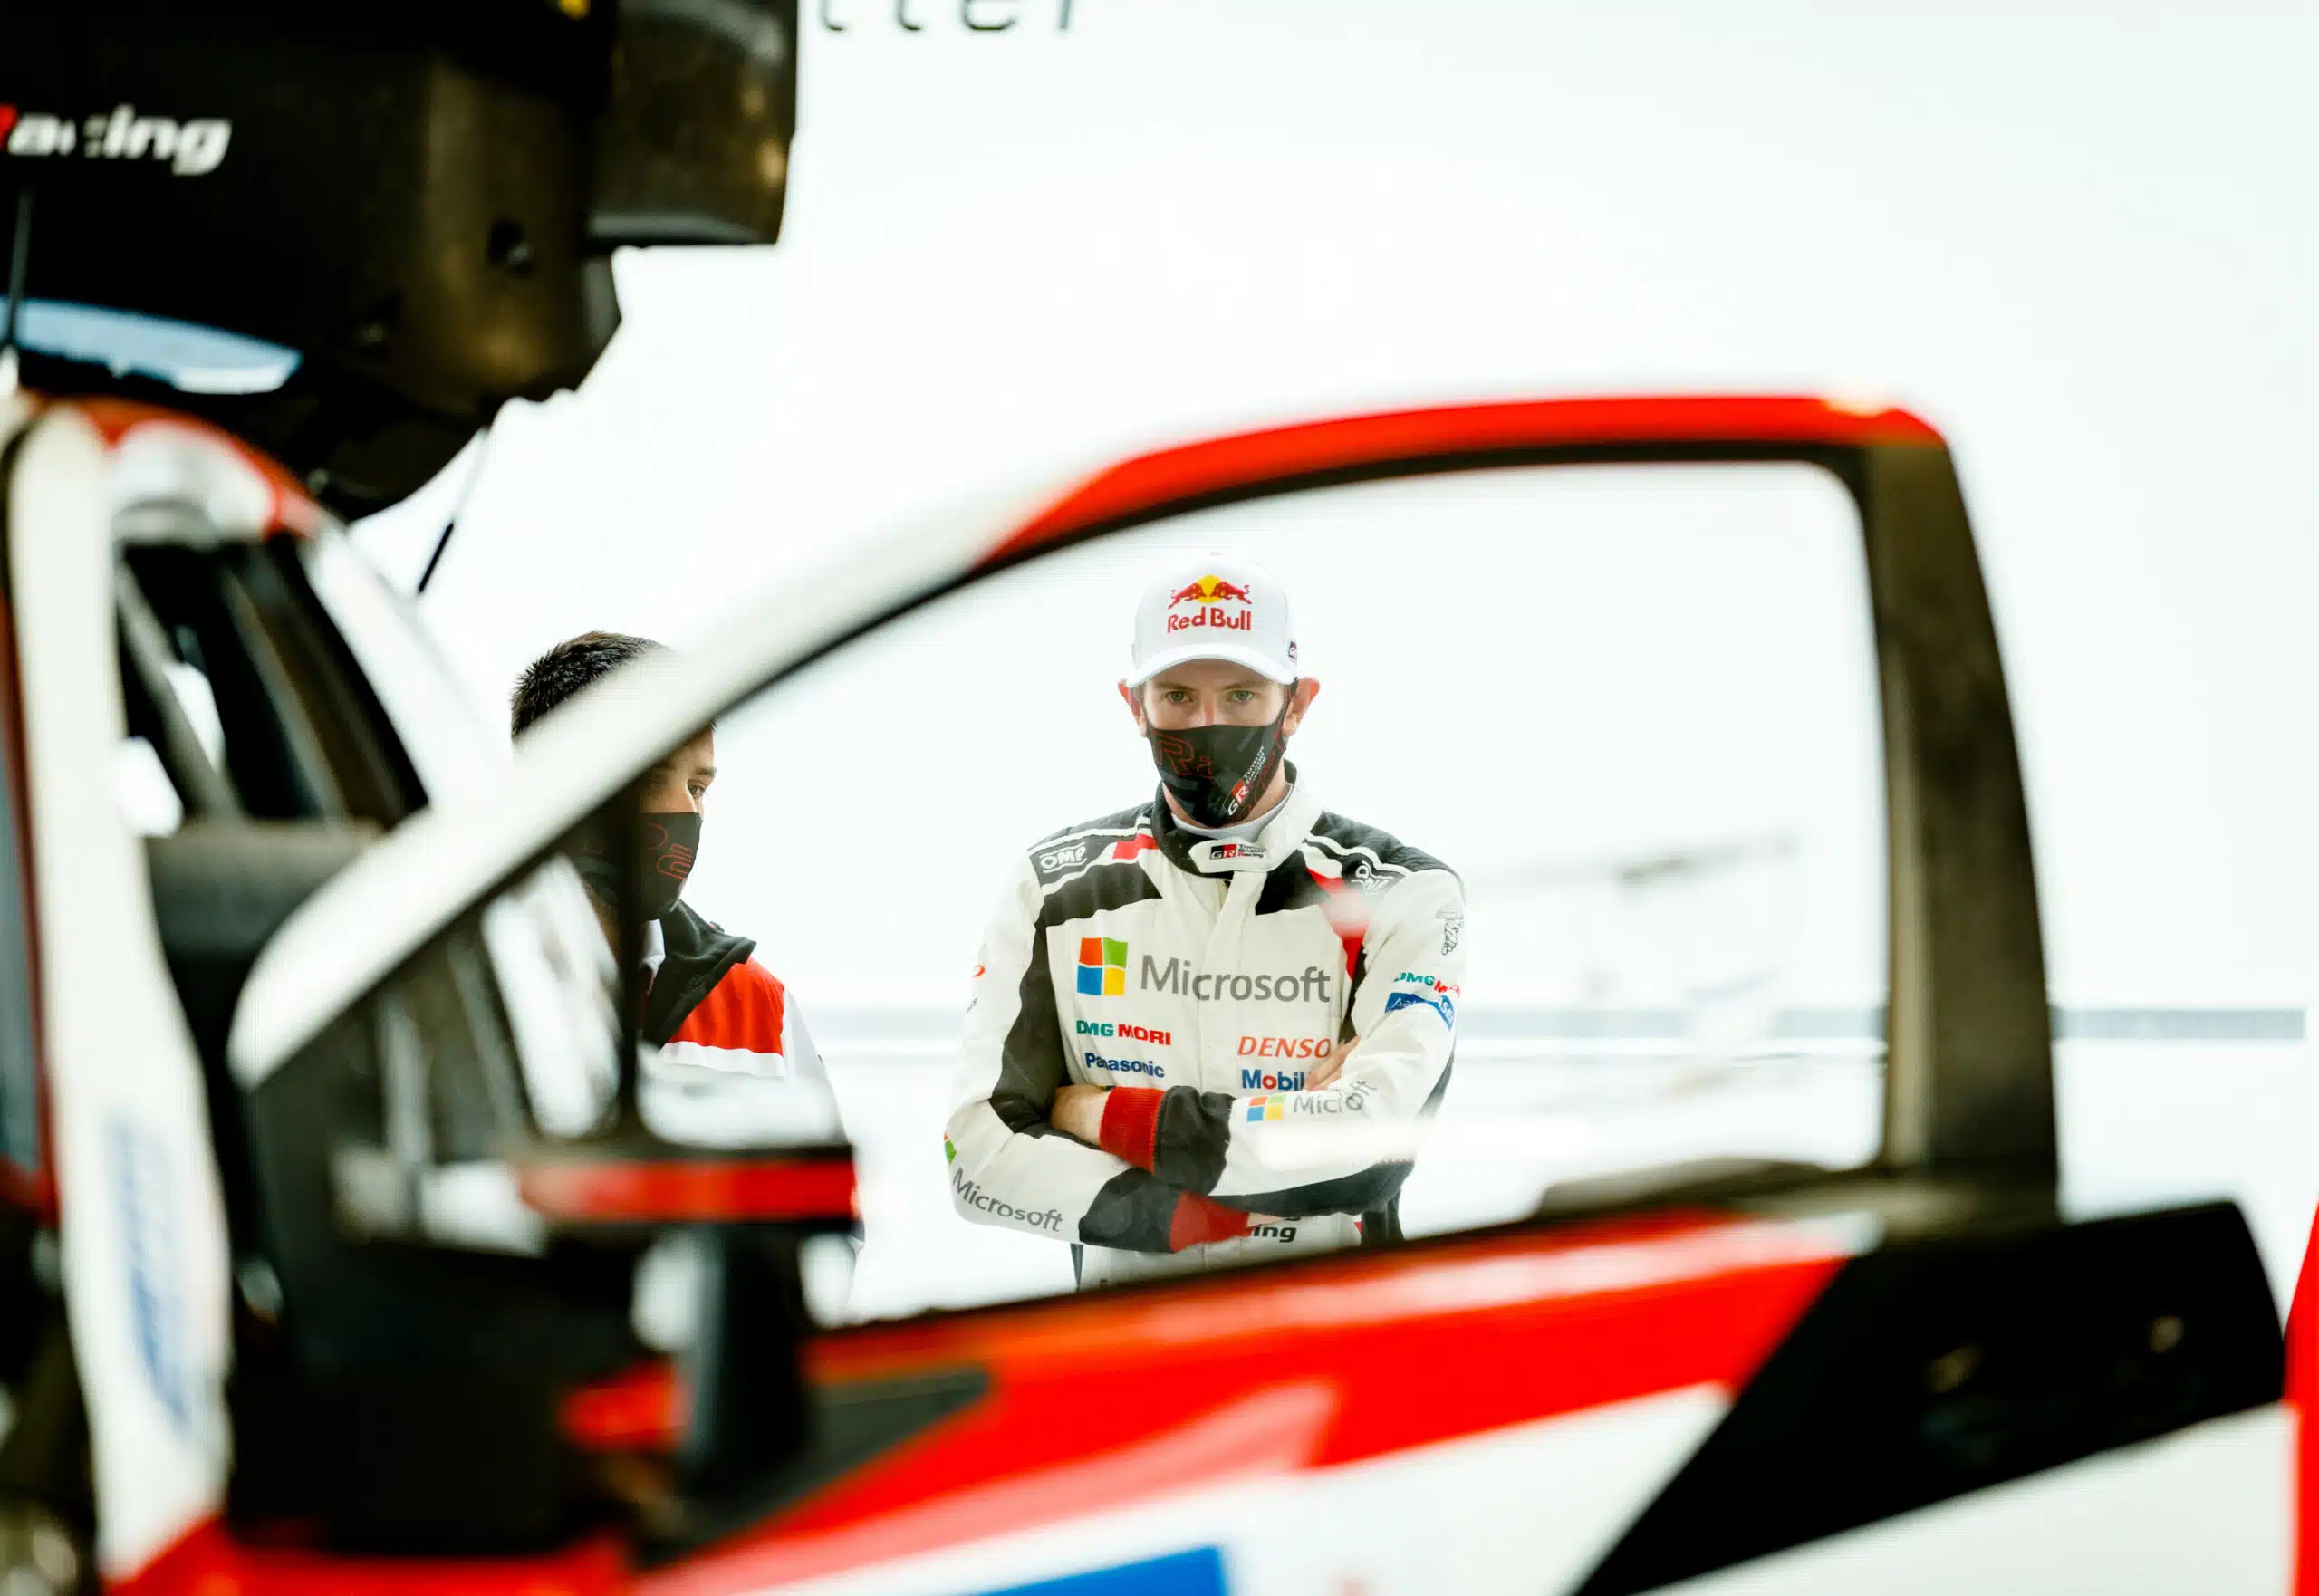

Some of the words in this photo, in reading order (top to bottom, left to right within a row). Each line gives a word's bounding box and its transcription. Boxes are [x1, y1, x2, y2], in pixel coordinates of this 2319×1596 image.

[0, 101, 232, 176] acing
[1167, 606, 1206, 633] Red
[1210, 607, 1252, 631] Bull
[1228, 785, 1249, 816] GR
[1041, 846, 1087, 870] OMP
[1211, 849, 1236, 859] GR
[1140, 954, 1331, 1003] Microsoft
[1076, 1020, 1114, 1037] DMG
[1118, 1024, 1171, 1046] MORI
[1237, 1035, 1332, 1059] DENSO
[1084, 1052, 1166, 1078] Panasonic
[1241, 1069, 1305, 1091] Mobil
[952, 1166, 1063, 1232] Microsoft
[1254, 1226, 1297, 1243] ing
